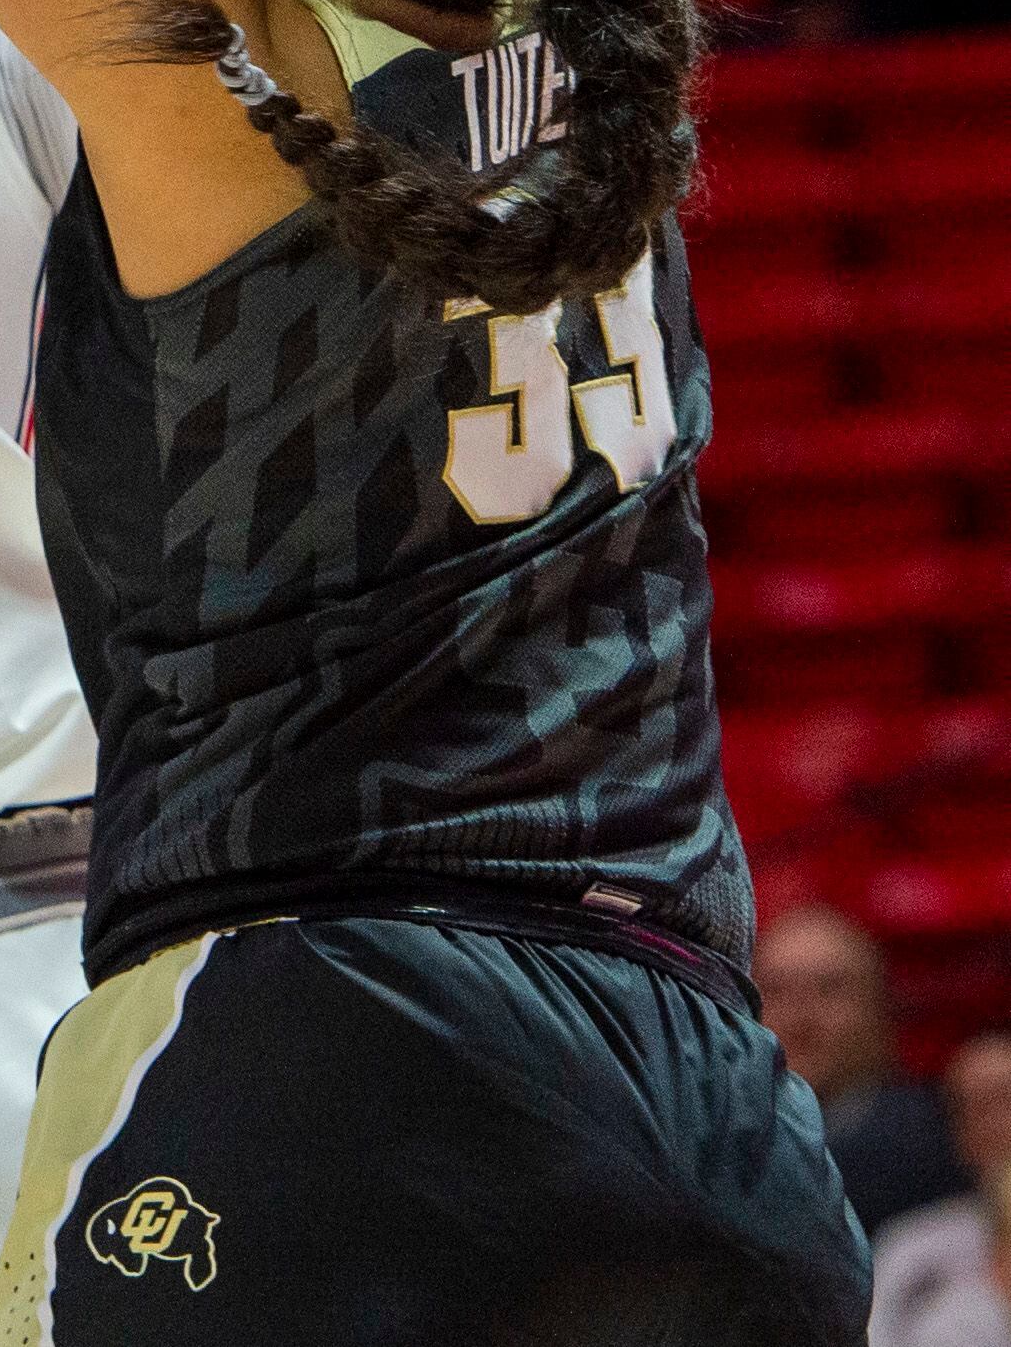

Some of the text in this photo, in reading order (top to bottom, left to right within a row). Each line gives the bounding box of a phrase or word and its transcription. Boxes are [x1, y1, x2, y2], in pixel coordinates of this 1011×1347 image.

[451, 32, 577, 172] TUITE
[442, 244, 678, 525] 33
[120, 1191, 188, 1254] CU
